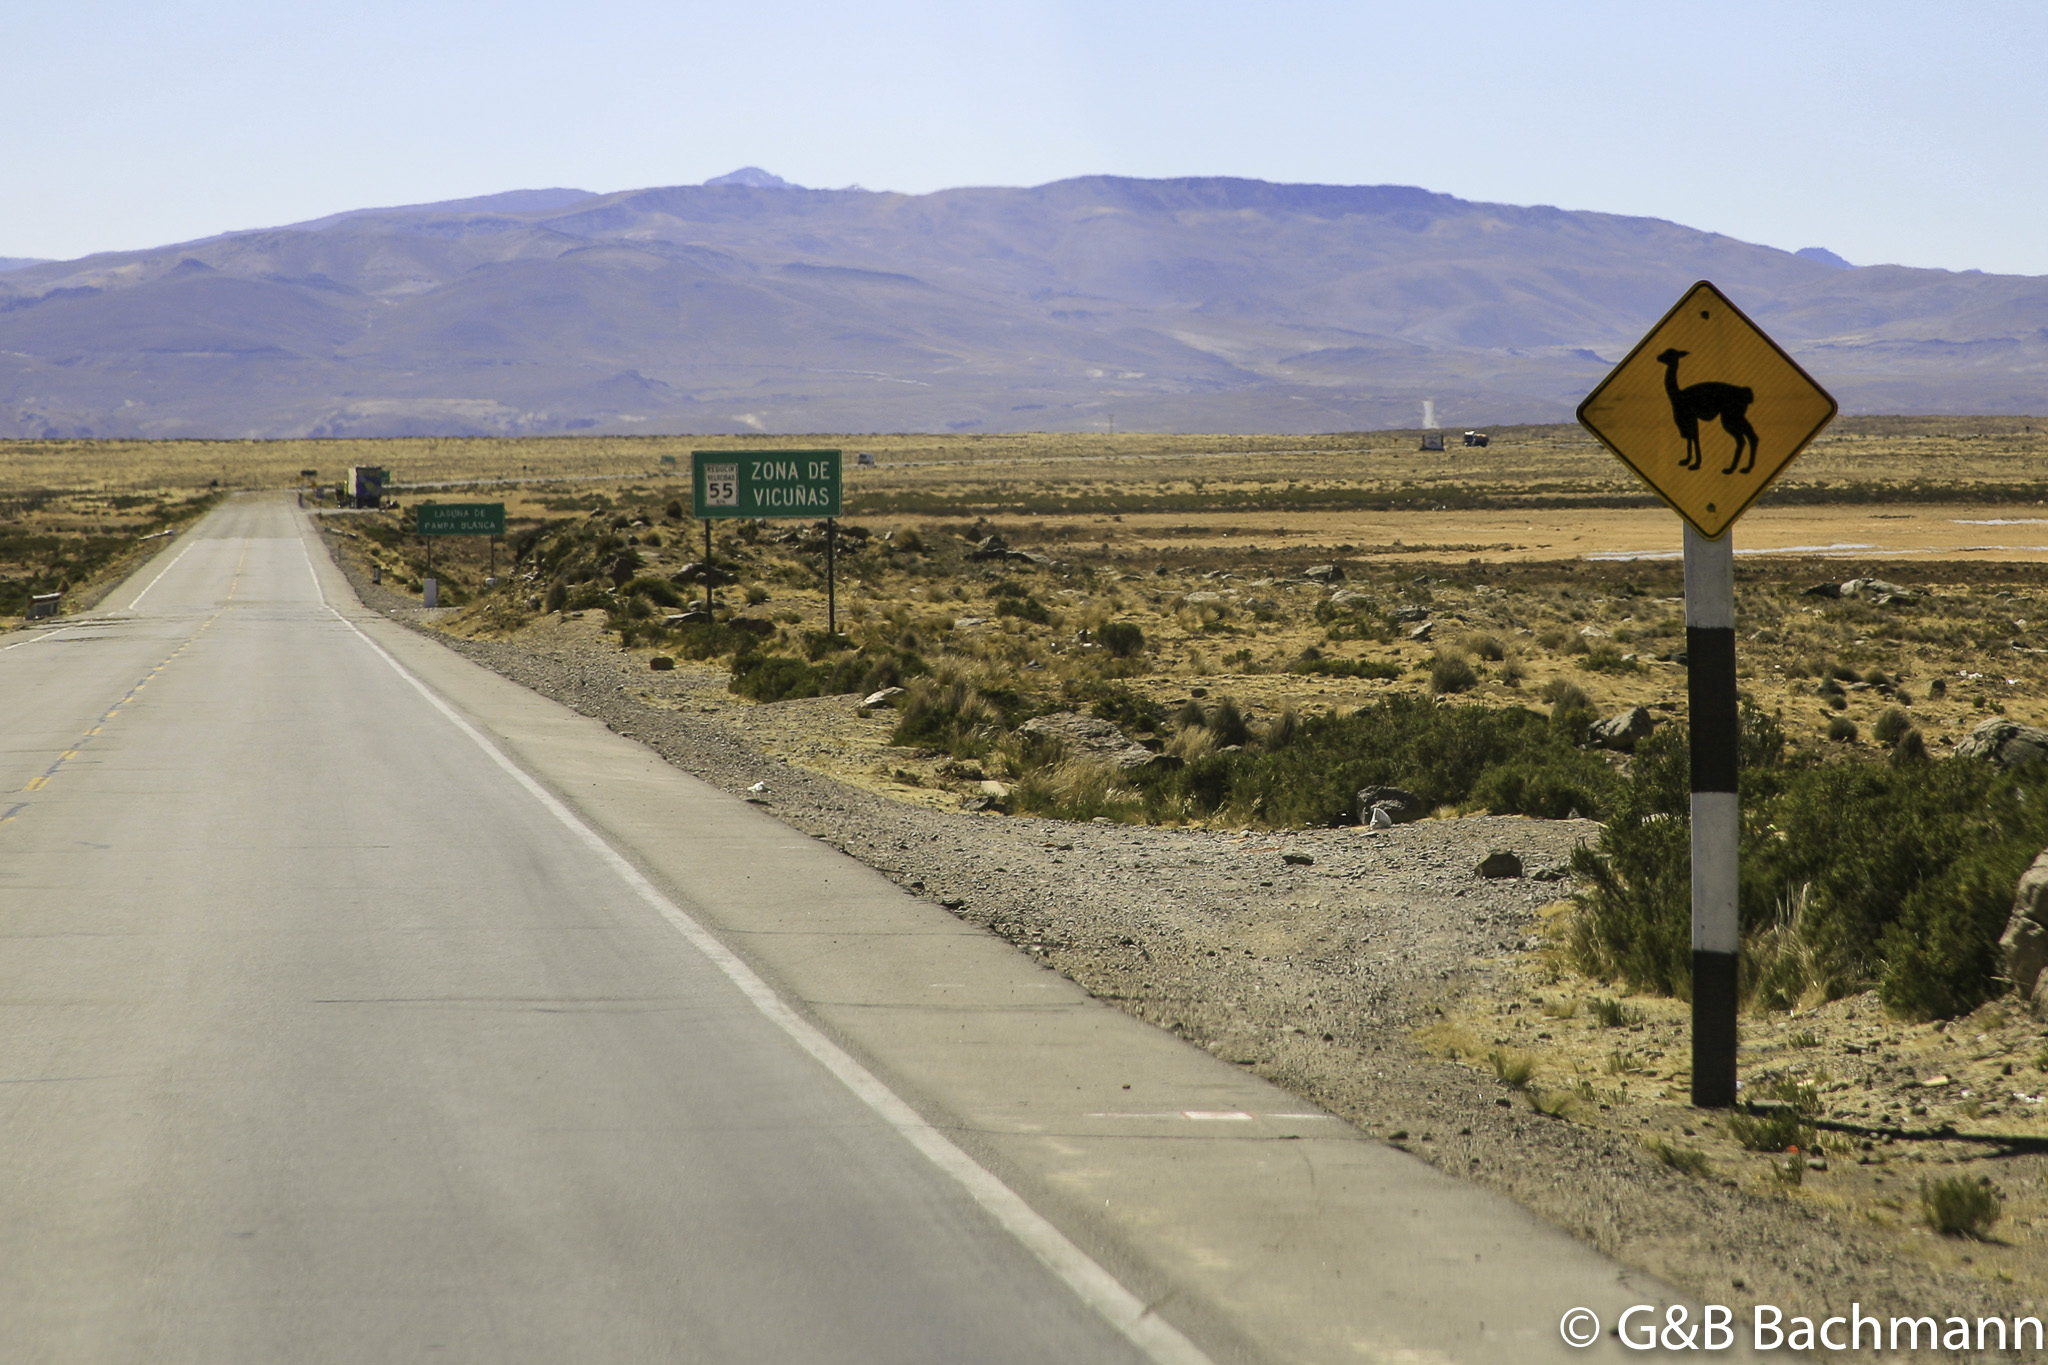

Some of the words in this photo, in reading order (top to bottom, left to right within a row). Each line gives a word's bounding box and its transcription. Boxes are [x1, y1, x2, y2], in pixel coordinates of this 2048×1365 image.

[707, 465, 735, 473] REDUCIR
[751, 461, 799, 480] ZONA
[808, 461, 830, 480] DE
[709, 483, 734, 499] 55
[753, 485, 829, 507] VICUÑAS
[434, 509, 469, 518] LAGUNA
[474, 508, 486, 518] DE
[424, 521, 456, 530] PAMPA
[461, 521, 496, 530] BLANCA
